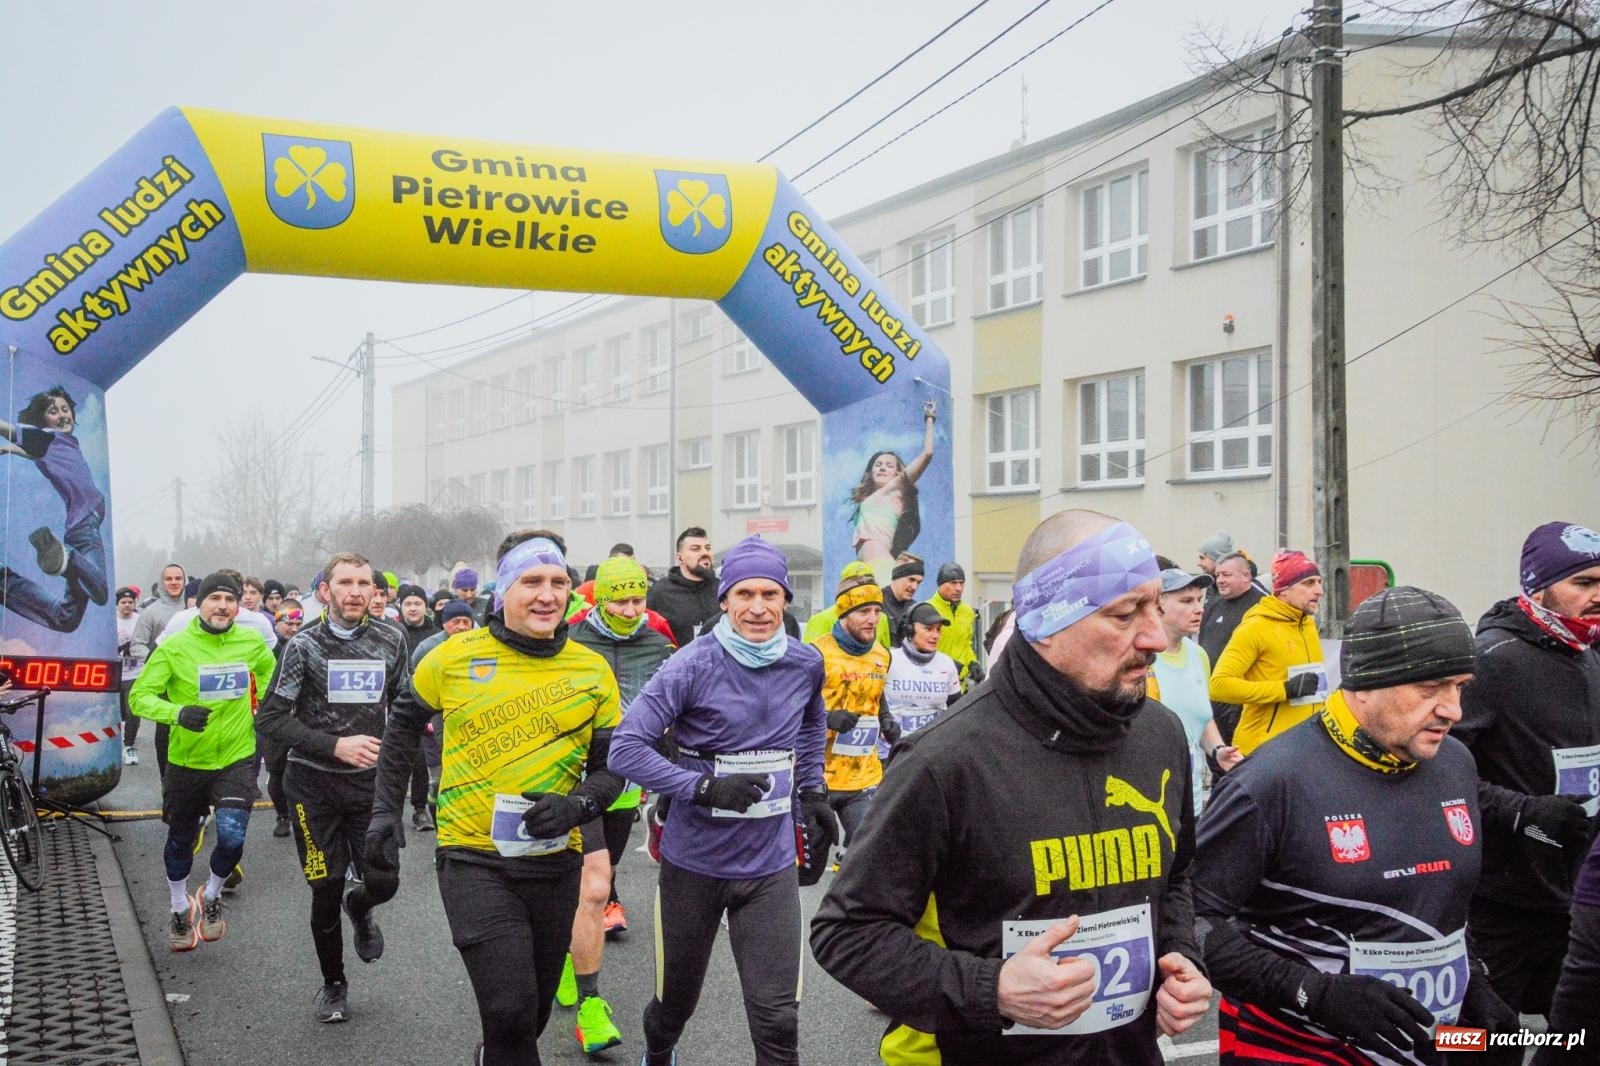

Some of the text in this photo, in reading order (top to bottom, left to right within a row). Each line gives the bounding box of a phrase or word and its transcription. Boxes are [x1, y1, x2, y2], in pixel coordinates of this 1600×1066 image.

[431, 149, 587, 183] Gmina
[392, 174, 629, 221] Pietrowice
[0, 156, 195, 321] Gmina ludzi
[422, 215, 597, 254] Wielkie
[46, 199, 226, 355] aktywnych
[787, 210, 922, 361] Gmina ludzi
[763, 242, 896, 384] aktywnych
[611, 581, 636, 592] XYZ
[214, 673, 237, 690] 75
[340, 671, 377, 690] 154
[458, 678, 575, 746] JEJKOWICE
[467, 711, 559, 769] BIEGAJĄ
[851, 728, 870, 745] 97
[1324, 813, 1363, 822] POLSKA
[1030, 824, 1162, 896] PUMA
[1097, 914, 1140, 931] Pietrowickiej
[1405, 950, 1416, 958] po
